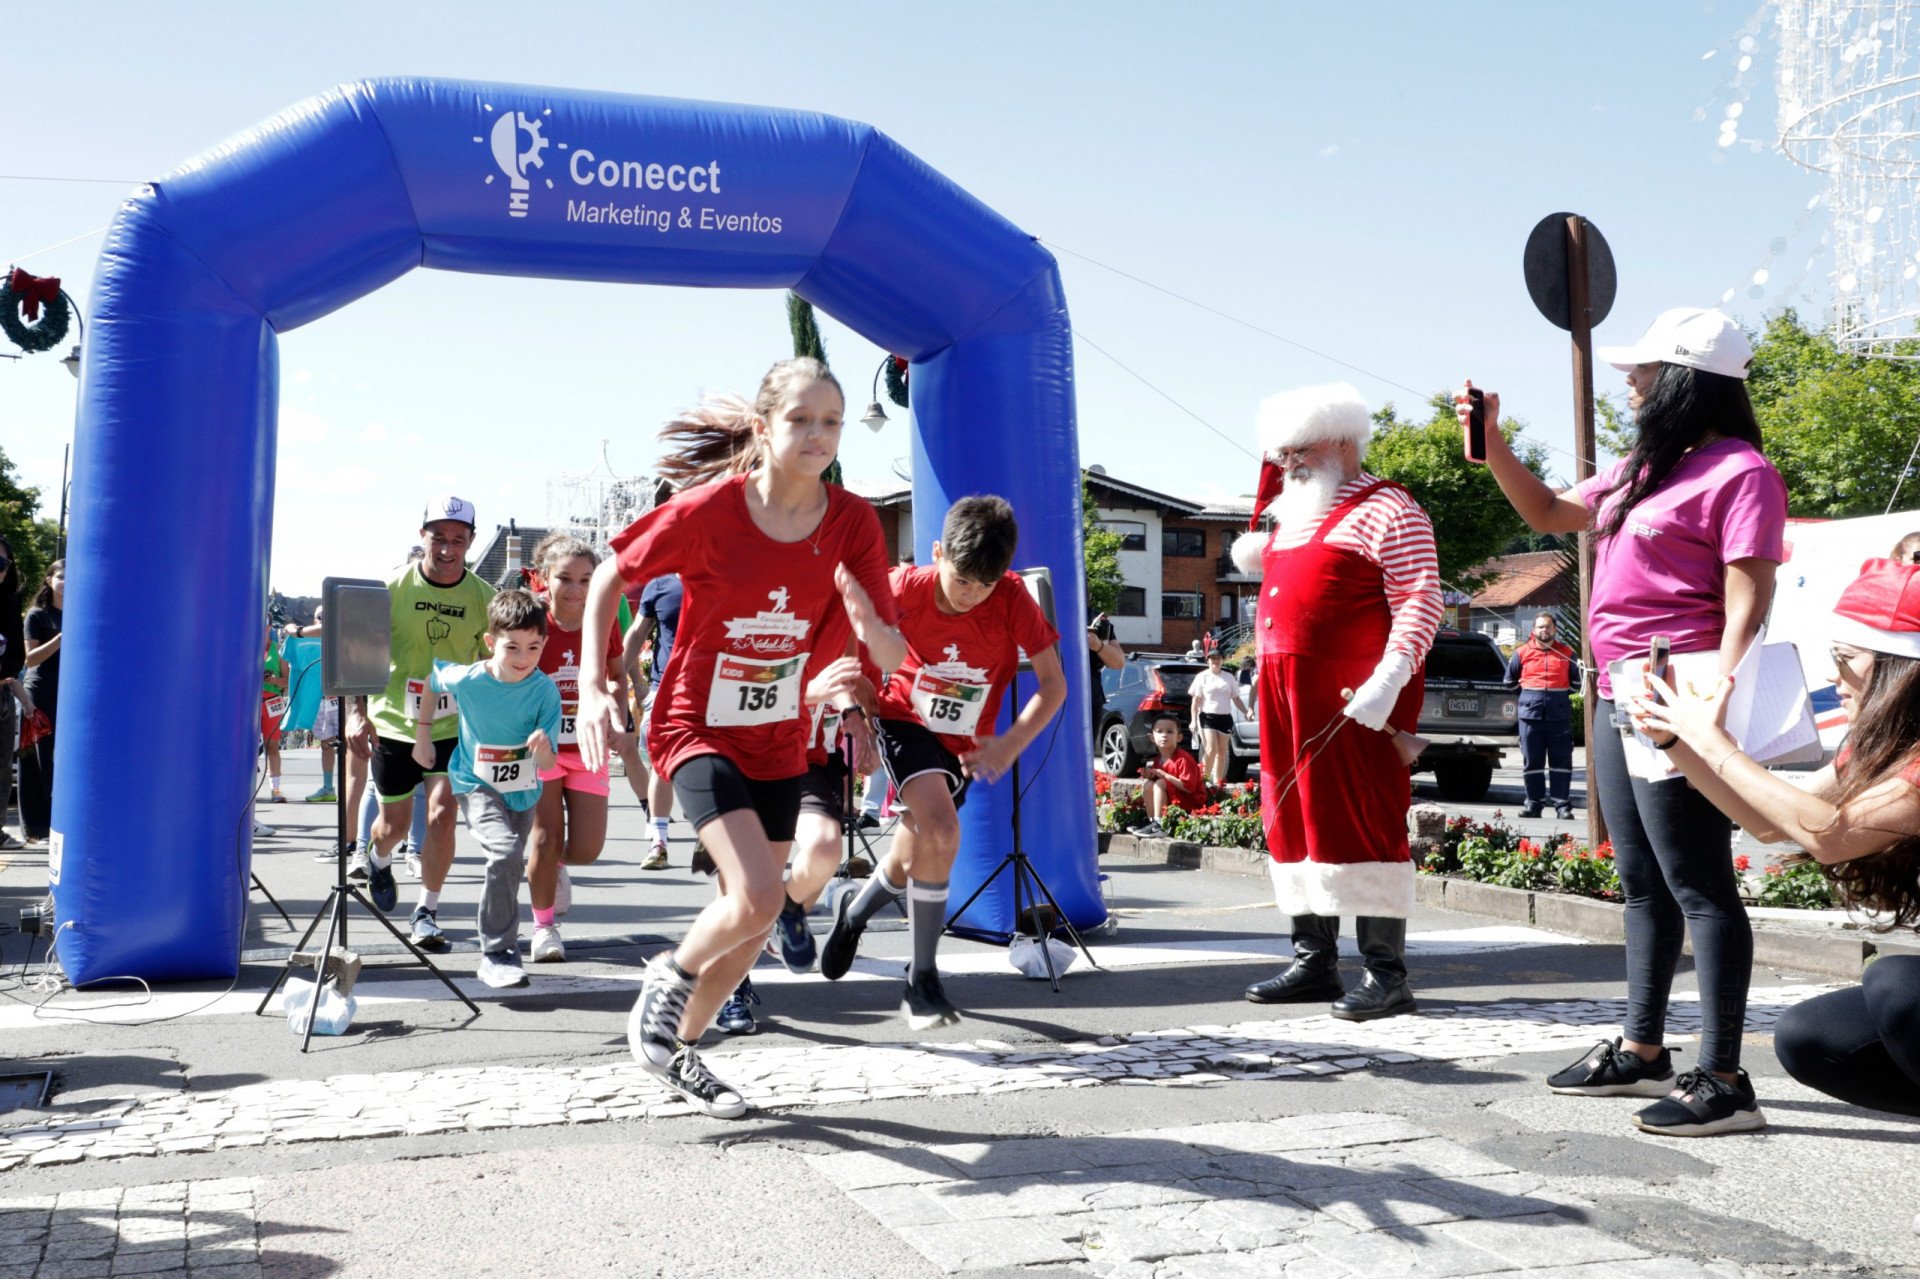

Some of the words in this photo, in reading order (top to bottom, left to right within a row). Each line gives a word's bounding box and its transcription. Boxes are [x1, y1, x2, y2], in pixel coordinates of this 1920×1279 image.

[569, 149, 721, 193] Conecct
[566, 200, 671, 233] Marketing
[677, 206, 693, 229] &
[700, 208, 783, 234] Eventos
[721, 667, 744, 678] KIDS
[738, 685, 778, 711] 136
[929, 698, 964, 721] 135
[560, 717, 577, 734] 13
[492, 763, 520, 783] 129
